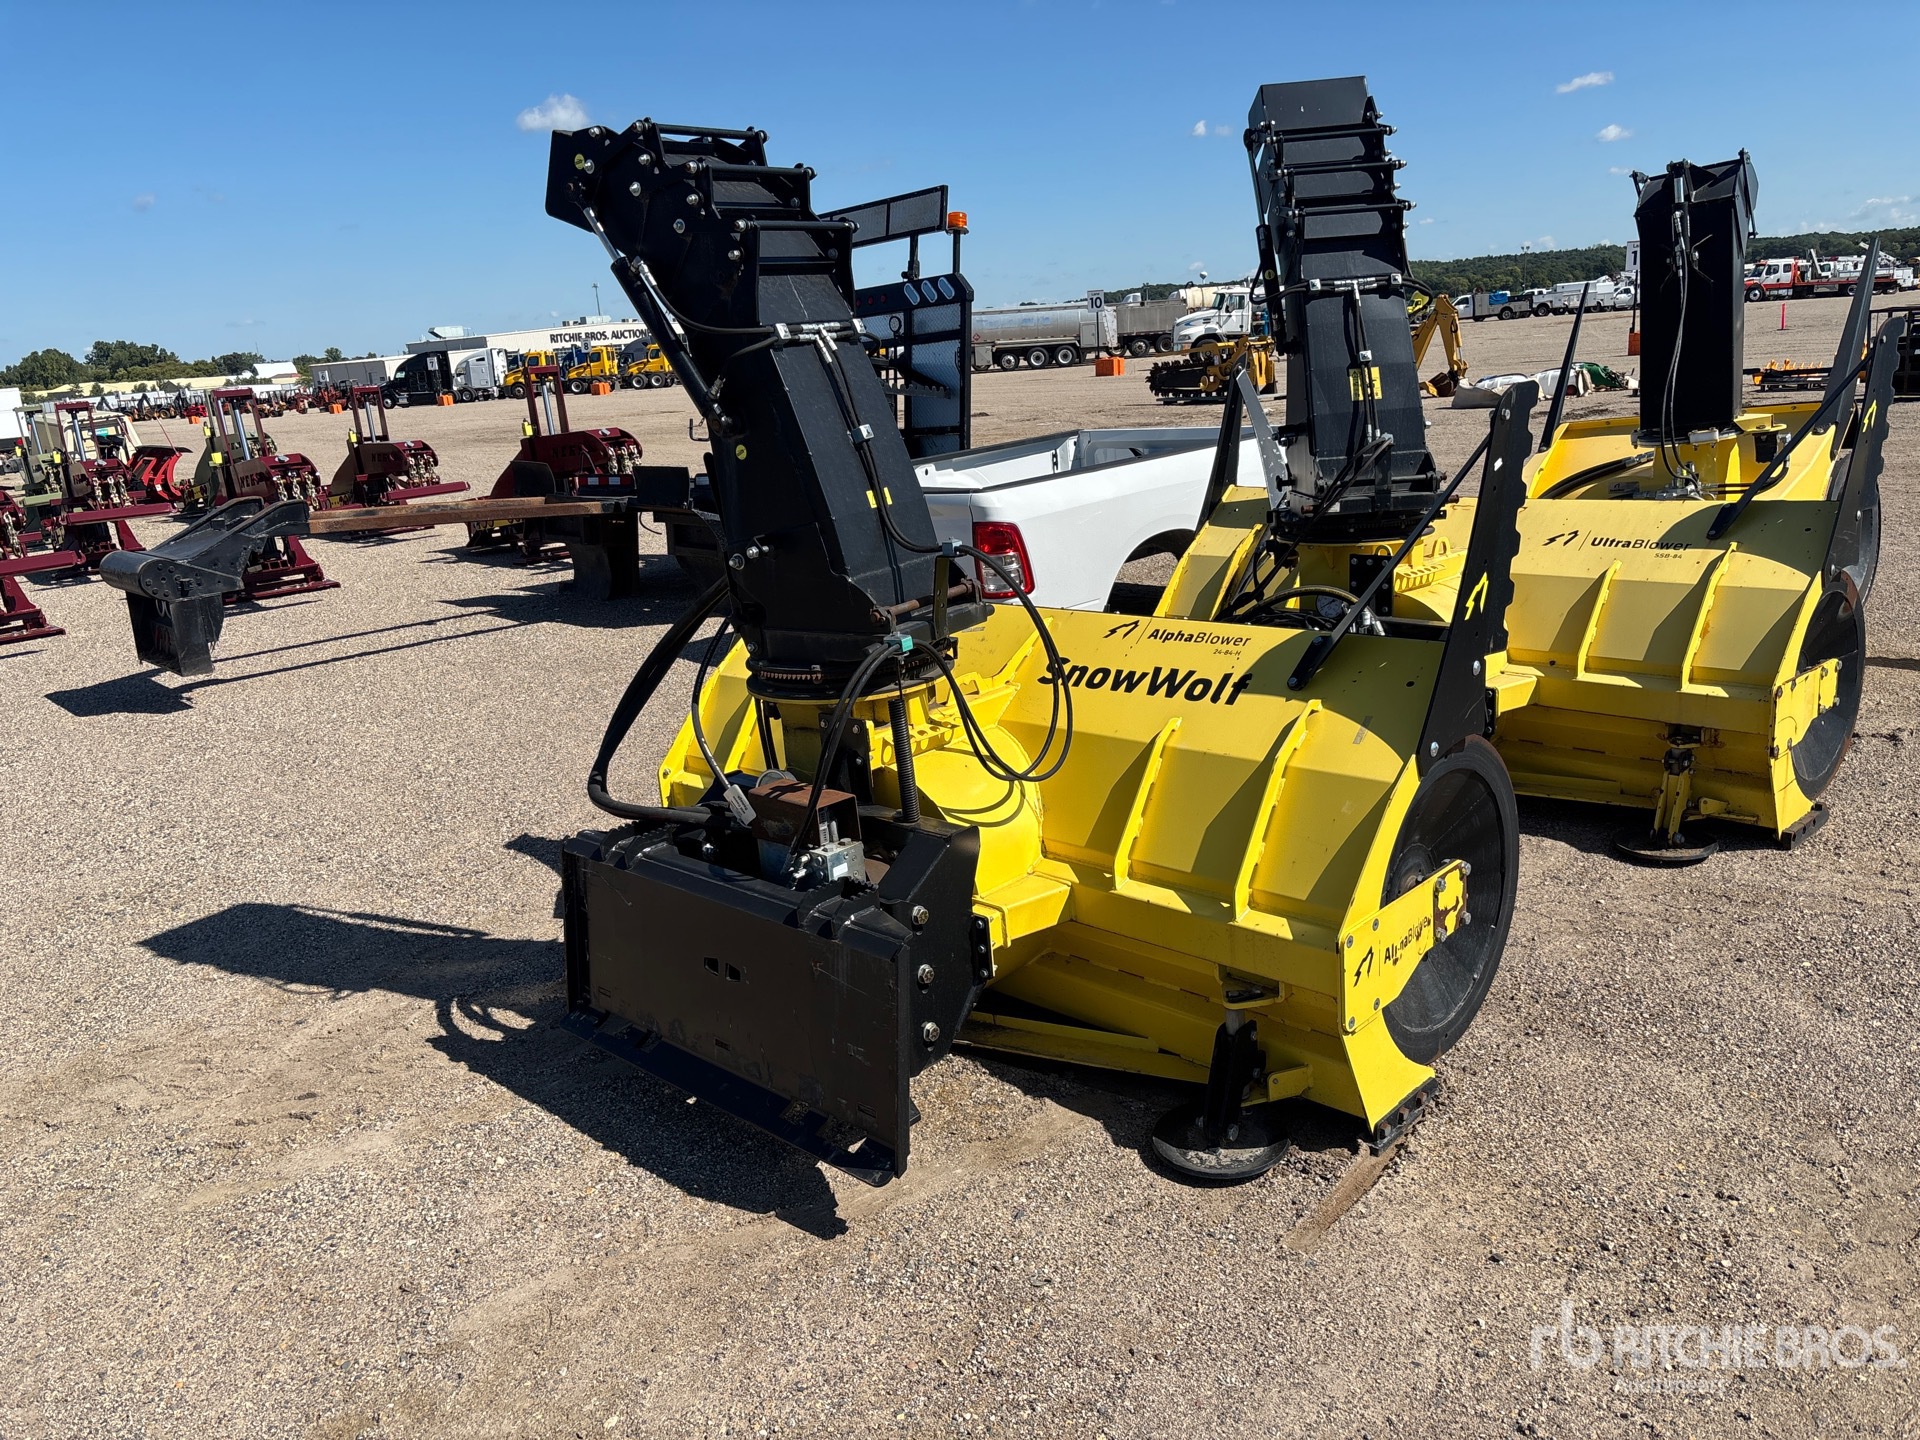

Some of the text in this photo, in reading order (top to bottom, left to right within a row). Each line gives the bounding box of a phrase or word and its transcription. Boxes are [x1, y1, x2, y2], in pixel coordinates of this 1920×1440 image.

[1090, 297, 1102, 309] 10
[550, 332, 582, 343] RITCHIE
[584, 331, 609, 341] BROS.
[583, 342, 589, 350] 8
[1590, 537, 1693, 551] UltraBlower
[1147, 627, 1252, 648] AlphaBlower
[1037, 656, 1253, 706] SnowWolf
